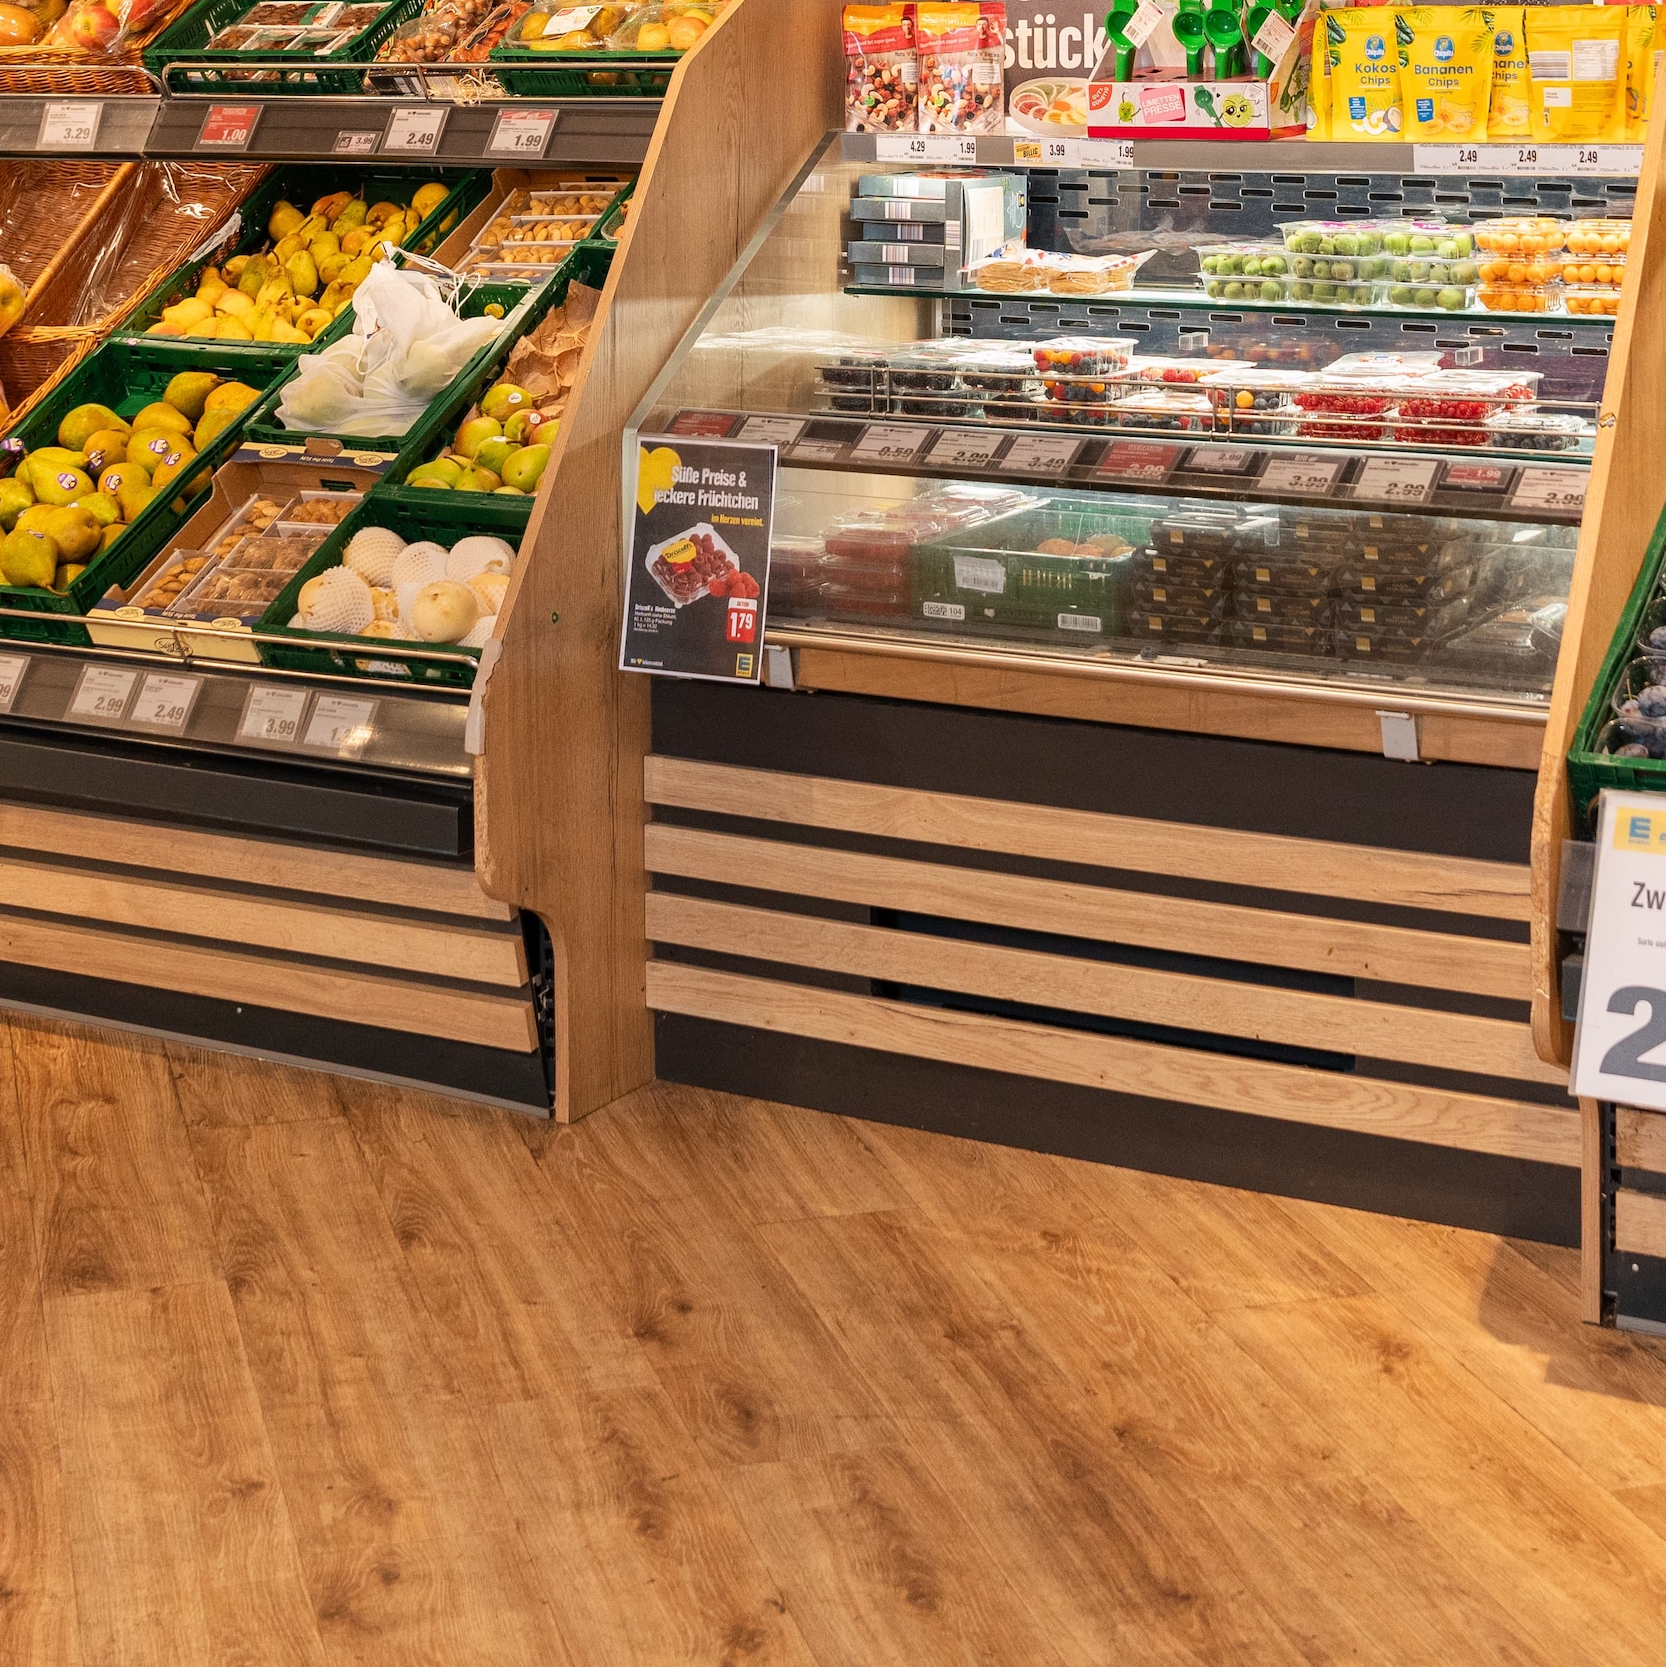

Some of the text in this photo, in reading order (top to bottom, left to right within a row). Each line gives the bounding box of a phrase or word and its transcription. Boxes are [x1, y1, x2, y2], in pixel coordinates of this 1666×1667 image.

[1355, 63, 1397, 73] Kokos
[1414, 65, 1473, 75] Bananen
[1360, 76, 1390, 87] Chips
[1428, 77, 1459, 87] Chips
[1141, 93, 1181, 108] LIMETTEN
[1144, 102, 1183, 116] PRESSE
[63, 127, 91, 140] 3.29
[222, 129, 247, 142] 1.00
[407, 133, 434, 146] 2.49
[355, 136, 373, 145] 3.99
[514, 135, 541, 148] 1.99
[911, 141, 925, 152] 4.29
[960, 142, 975, 154] 1.99
[1050, 144, 1065, 156] 3.99
[1118, 146, 1134, 158] 1.99
[1460, 150, 1477, 163] 2.49
[1519, 150, 1537, 163] 2.49
[1579, 151, 1598, 163] 2.49
[671, 466, 747, 487] Süße Preise &
[1475, 469, 1502, 478] 1.99
[1385, 482, 1426, 497] 2.99
[654, 487, 759, 510] leckere Früchtchen
[1545, 492, 1585, 506] 2.99
[711, 513, 764, 527] im Herzen vereint.
[949, 606, 962, 615] 104
[730, 612, 754, 638] 1.79
[93, 696, 123, 713] 2.99
[154, 703, 184, 721] 2.49
[265, 718, 295, 735] 3.99
[1637, 937, 1654, 946] Sorte
